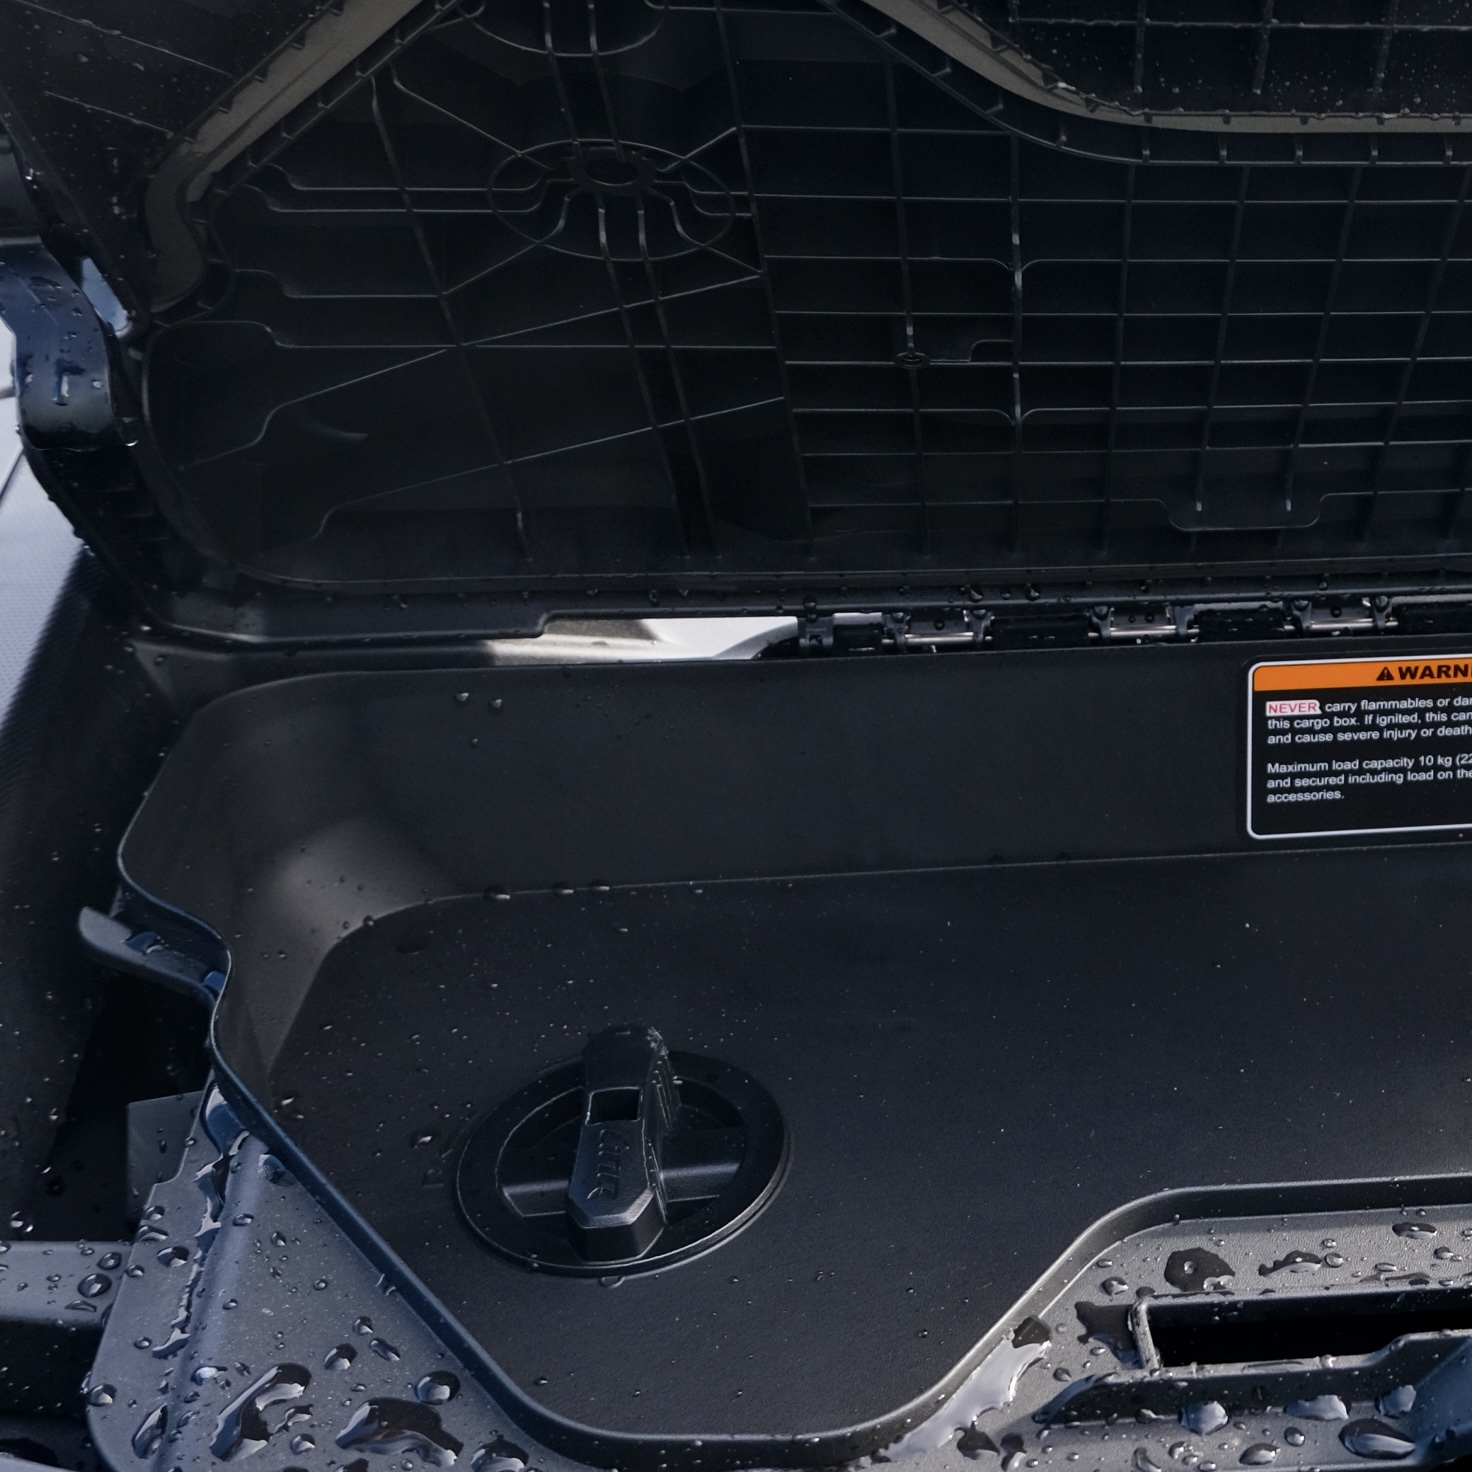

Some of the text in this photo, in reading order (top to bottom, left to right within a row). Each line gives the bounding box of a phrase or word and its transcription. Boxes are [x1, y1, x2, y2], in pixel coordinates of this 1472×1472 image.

[1268, 702, 1317, 714] NEVER
[1325, 702, 1357, 713] carry
[1361, 698, 1433, 710] flammables
[1437, 698, 1450, 707] or
[1268, 718, 1290, 729] this
[1294, 718, 1330, 729] cargo
[1334, 716, 1360, 726] box.
[1365, 715, 1373, 724] If
[1376, 713, 1421, 726] ignited,
[1426, 710, 1447, 722] this
[1268, 733, 1291, 744] and
[1295, 733, 1333, 743] cause
[1337, 730, 1380, 741] severe
[1383, 728, 1417, 740] injury
[1421, 728, 1434, 737] or
[1267, 762, 1328, 773] Maximum
[1332, 759, 1359, 770] load
[1363, 757, 1414, 770] capacity
[1419, 755, 1433, 766] 10
[1437, 755, 1452, 767] kg
[1267, 777, 1290, 788] and
[1295, 774, 1344, 786] secured
[1349, 772, 1403, 784] including
[1407, 770, 1434, 781] load
[1437, 770, 1453, 779] on
[1266, 789, 1344, 803] accessories.
